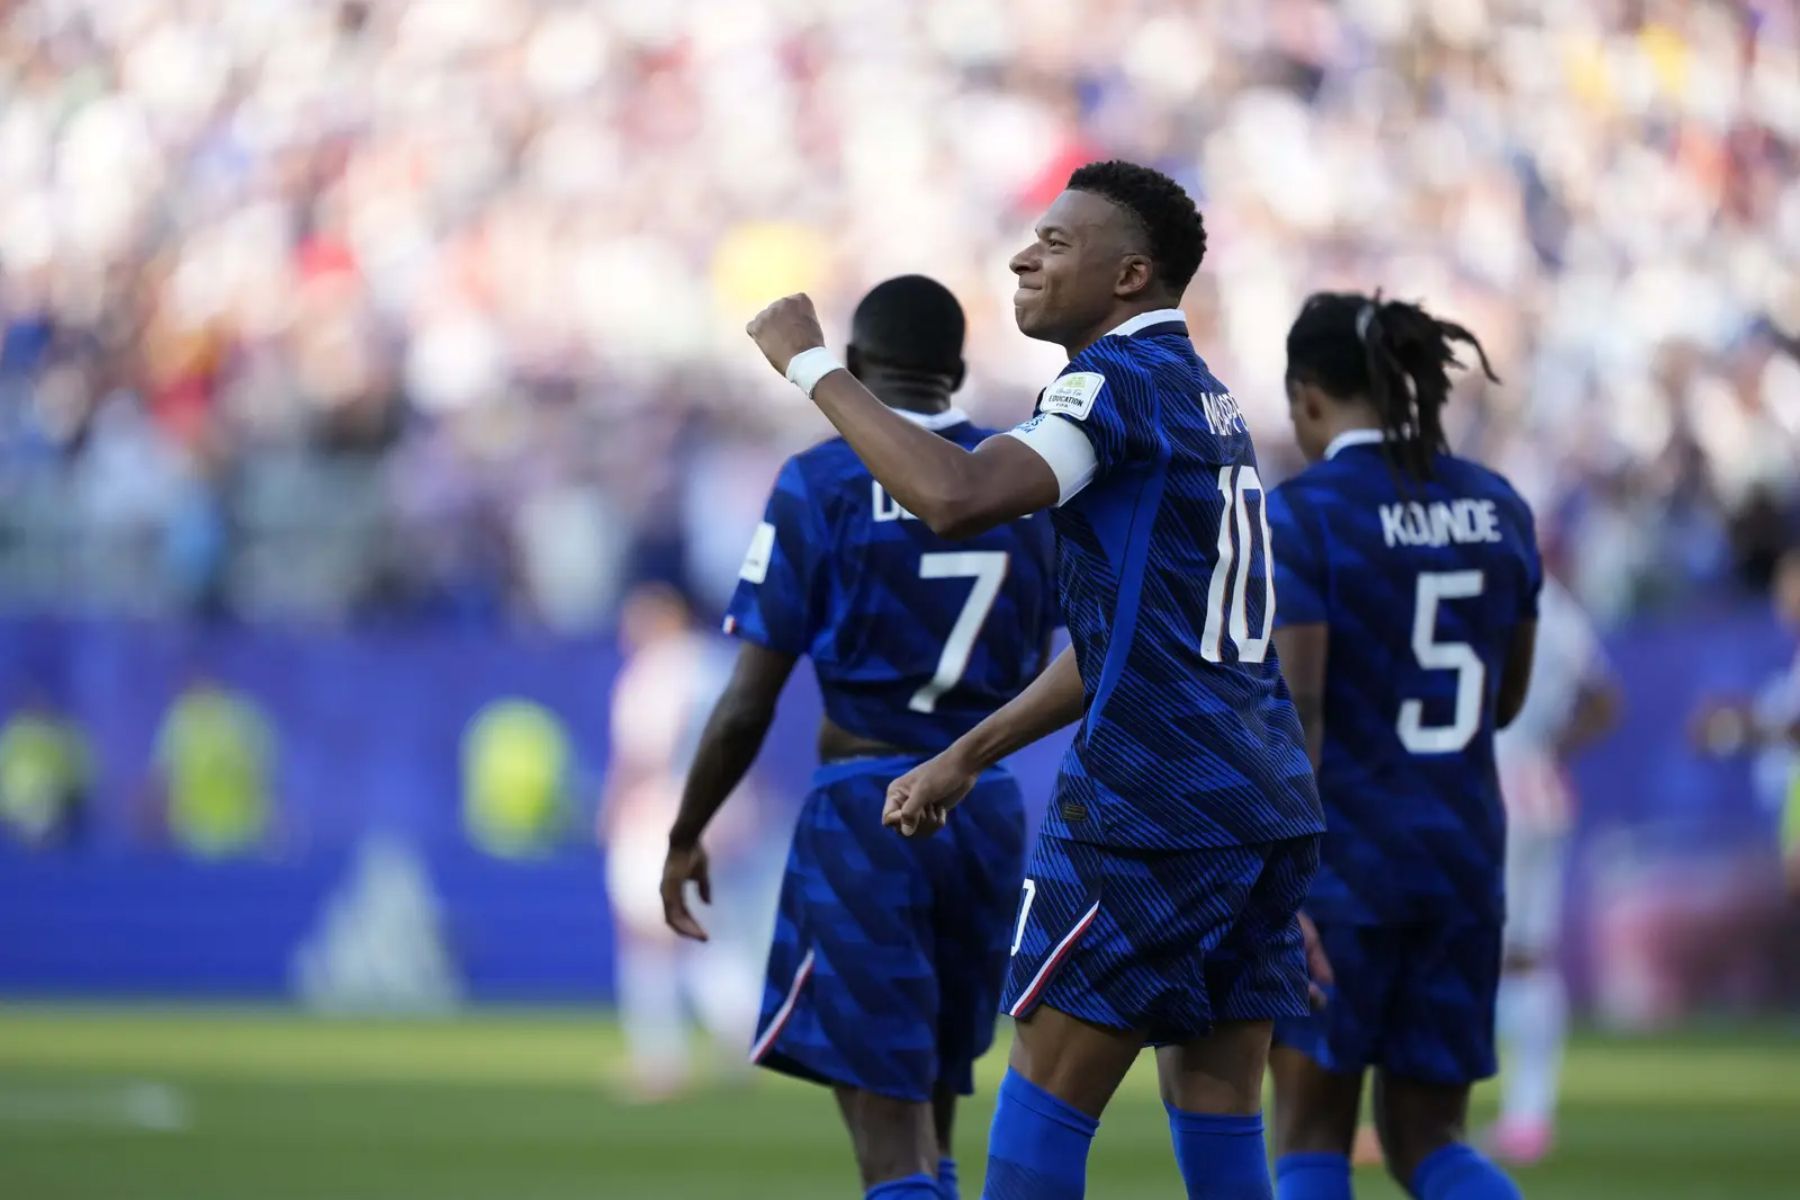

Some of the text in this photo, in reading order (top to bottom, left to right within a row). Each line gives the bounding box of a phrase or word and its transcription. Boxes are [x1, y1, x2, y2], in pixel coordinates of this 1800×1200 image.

[1048, 395, 1084, 408] EDUCATION
[908, 551, 1010, 714] 7
[1201, 465, 1276, 663] 10
[1396, 569, 1484, 754] 5
